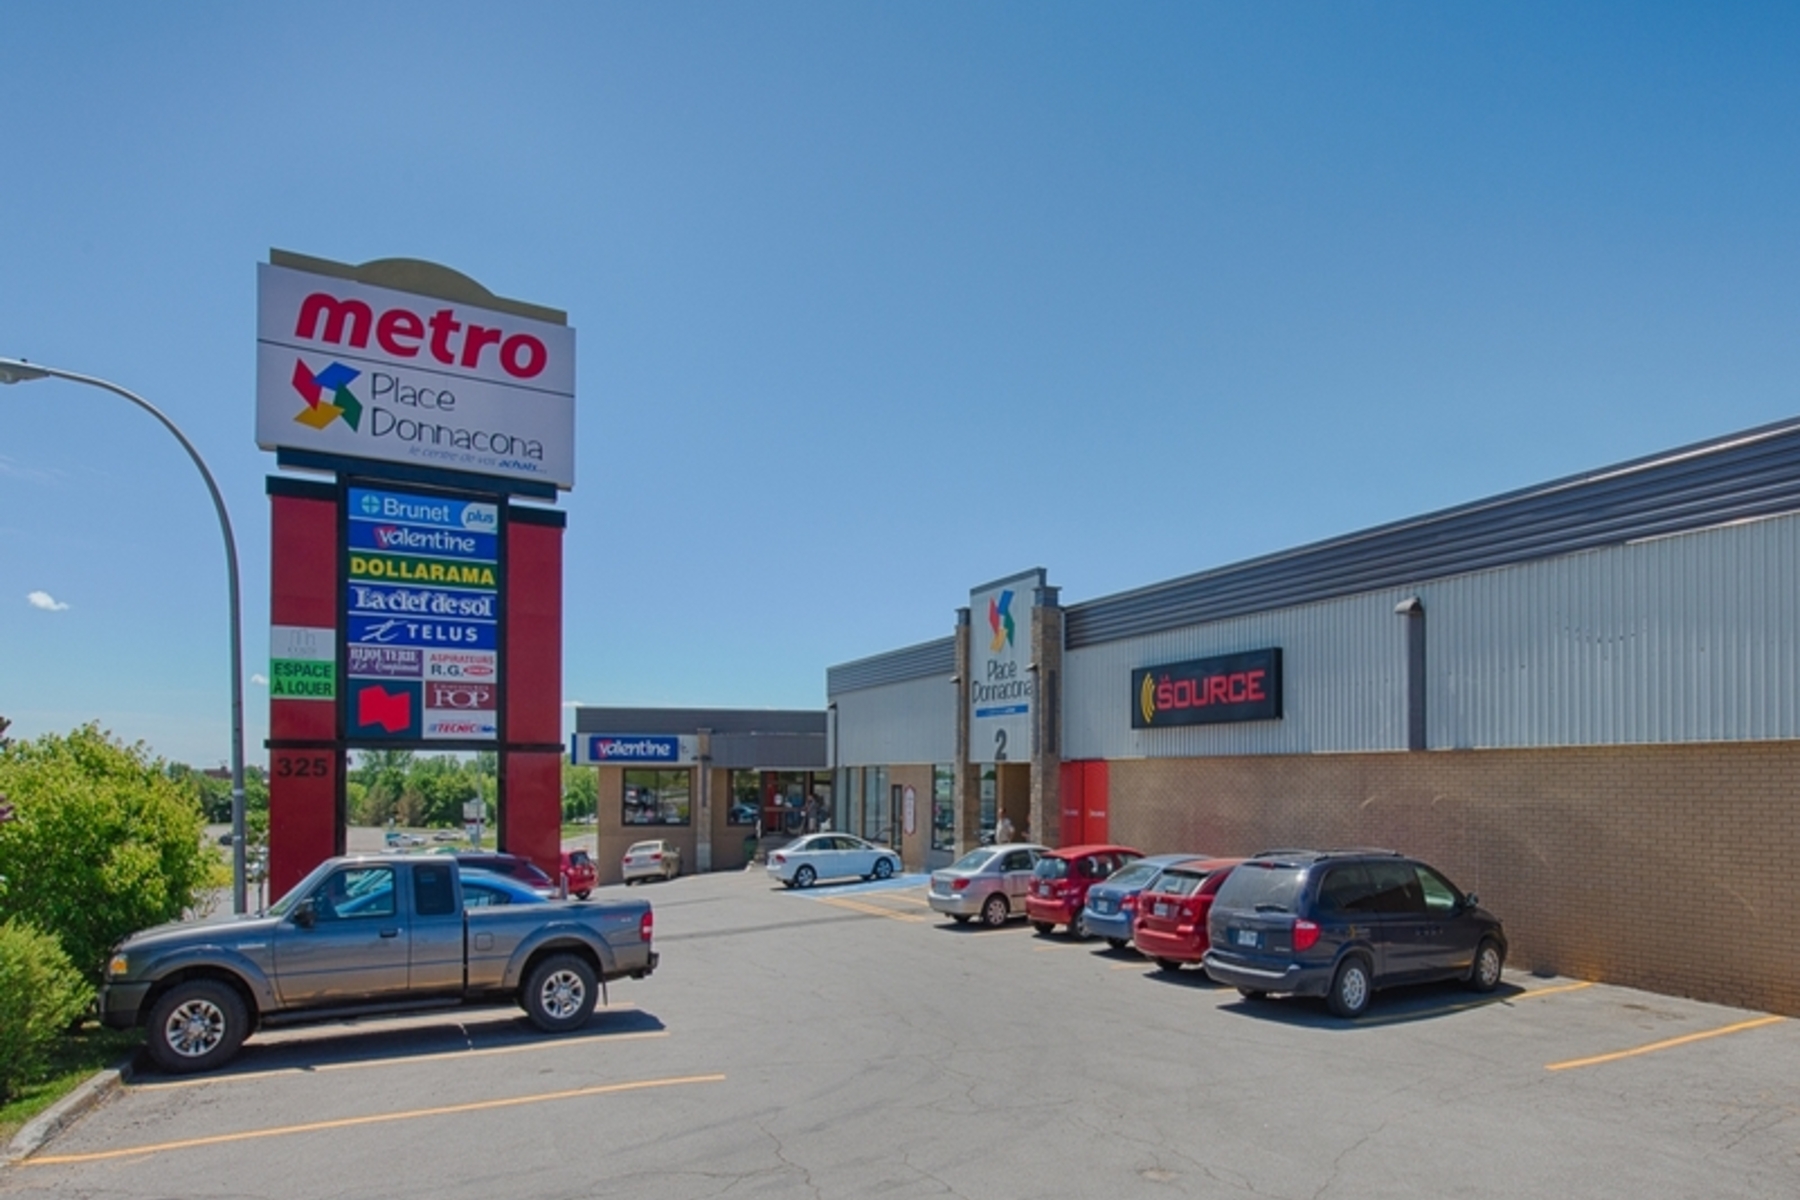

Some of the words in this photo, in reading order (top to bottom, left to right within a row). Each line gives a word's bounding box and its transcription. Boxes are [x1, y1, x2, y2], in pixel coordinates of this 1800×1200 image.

[294, 292, 548, 379] metro
[371, 372, 456, 411] Place
[371, 407, 544, 461] Donnacona
[383, 497, 450, 522] Brunet
[465, 509, 495, 524] plus
[350, 556, 496, 586] DOLLARAMA
[388, 589, 431, 612] clef
[431, 592, 458, 615] de
[459, 595, 496, 617] sol
[406, 623, 479, 643] TELUS
[274, 662, 332, 678] ESPACE
[987, 659, 1018, 680] Place
[273, 678, 285, 695] À
[287, 680, 332, 695] LOUER
[971, 679, 1032, 704] Donnacona
[1156, 670, 1266, 710] SOURCE
[994, 728, 1007, 761] 2
[277, 757, 329, 779] 325
